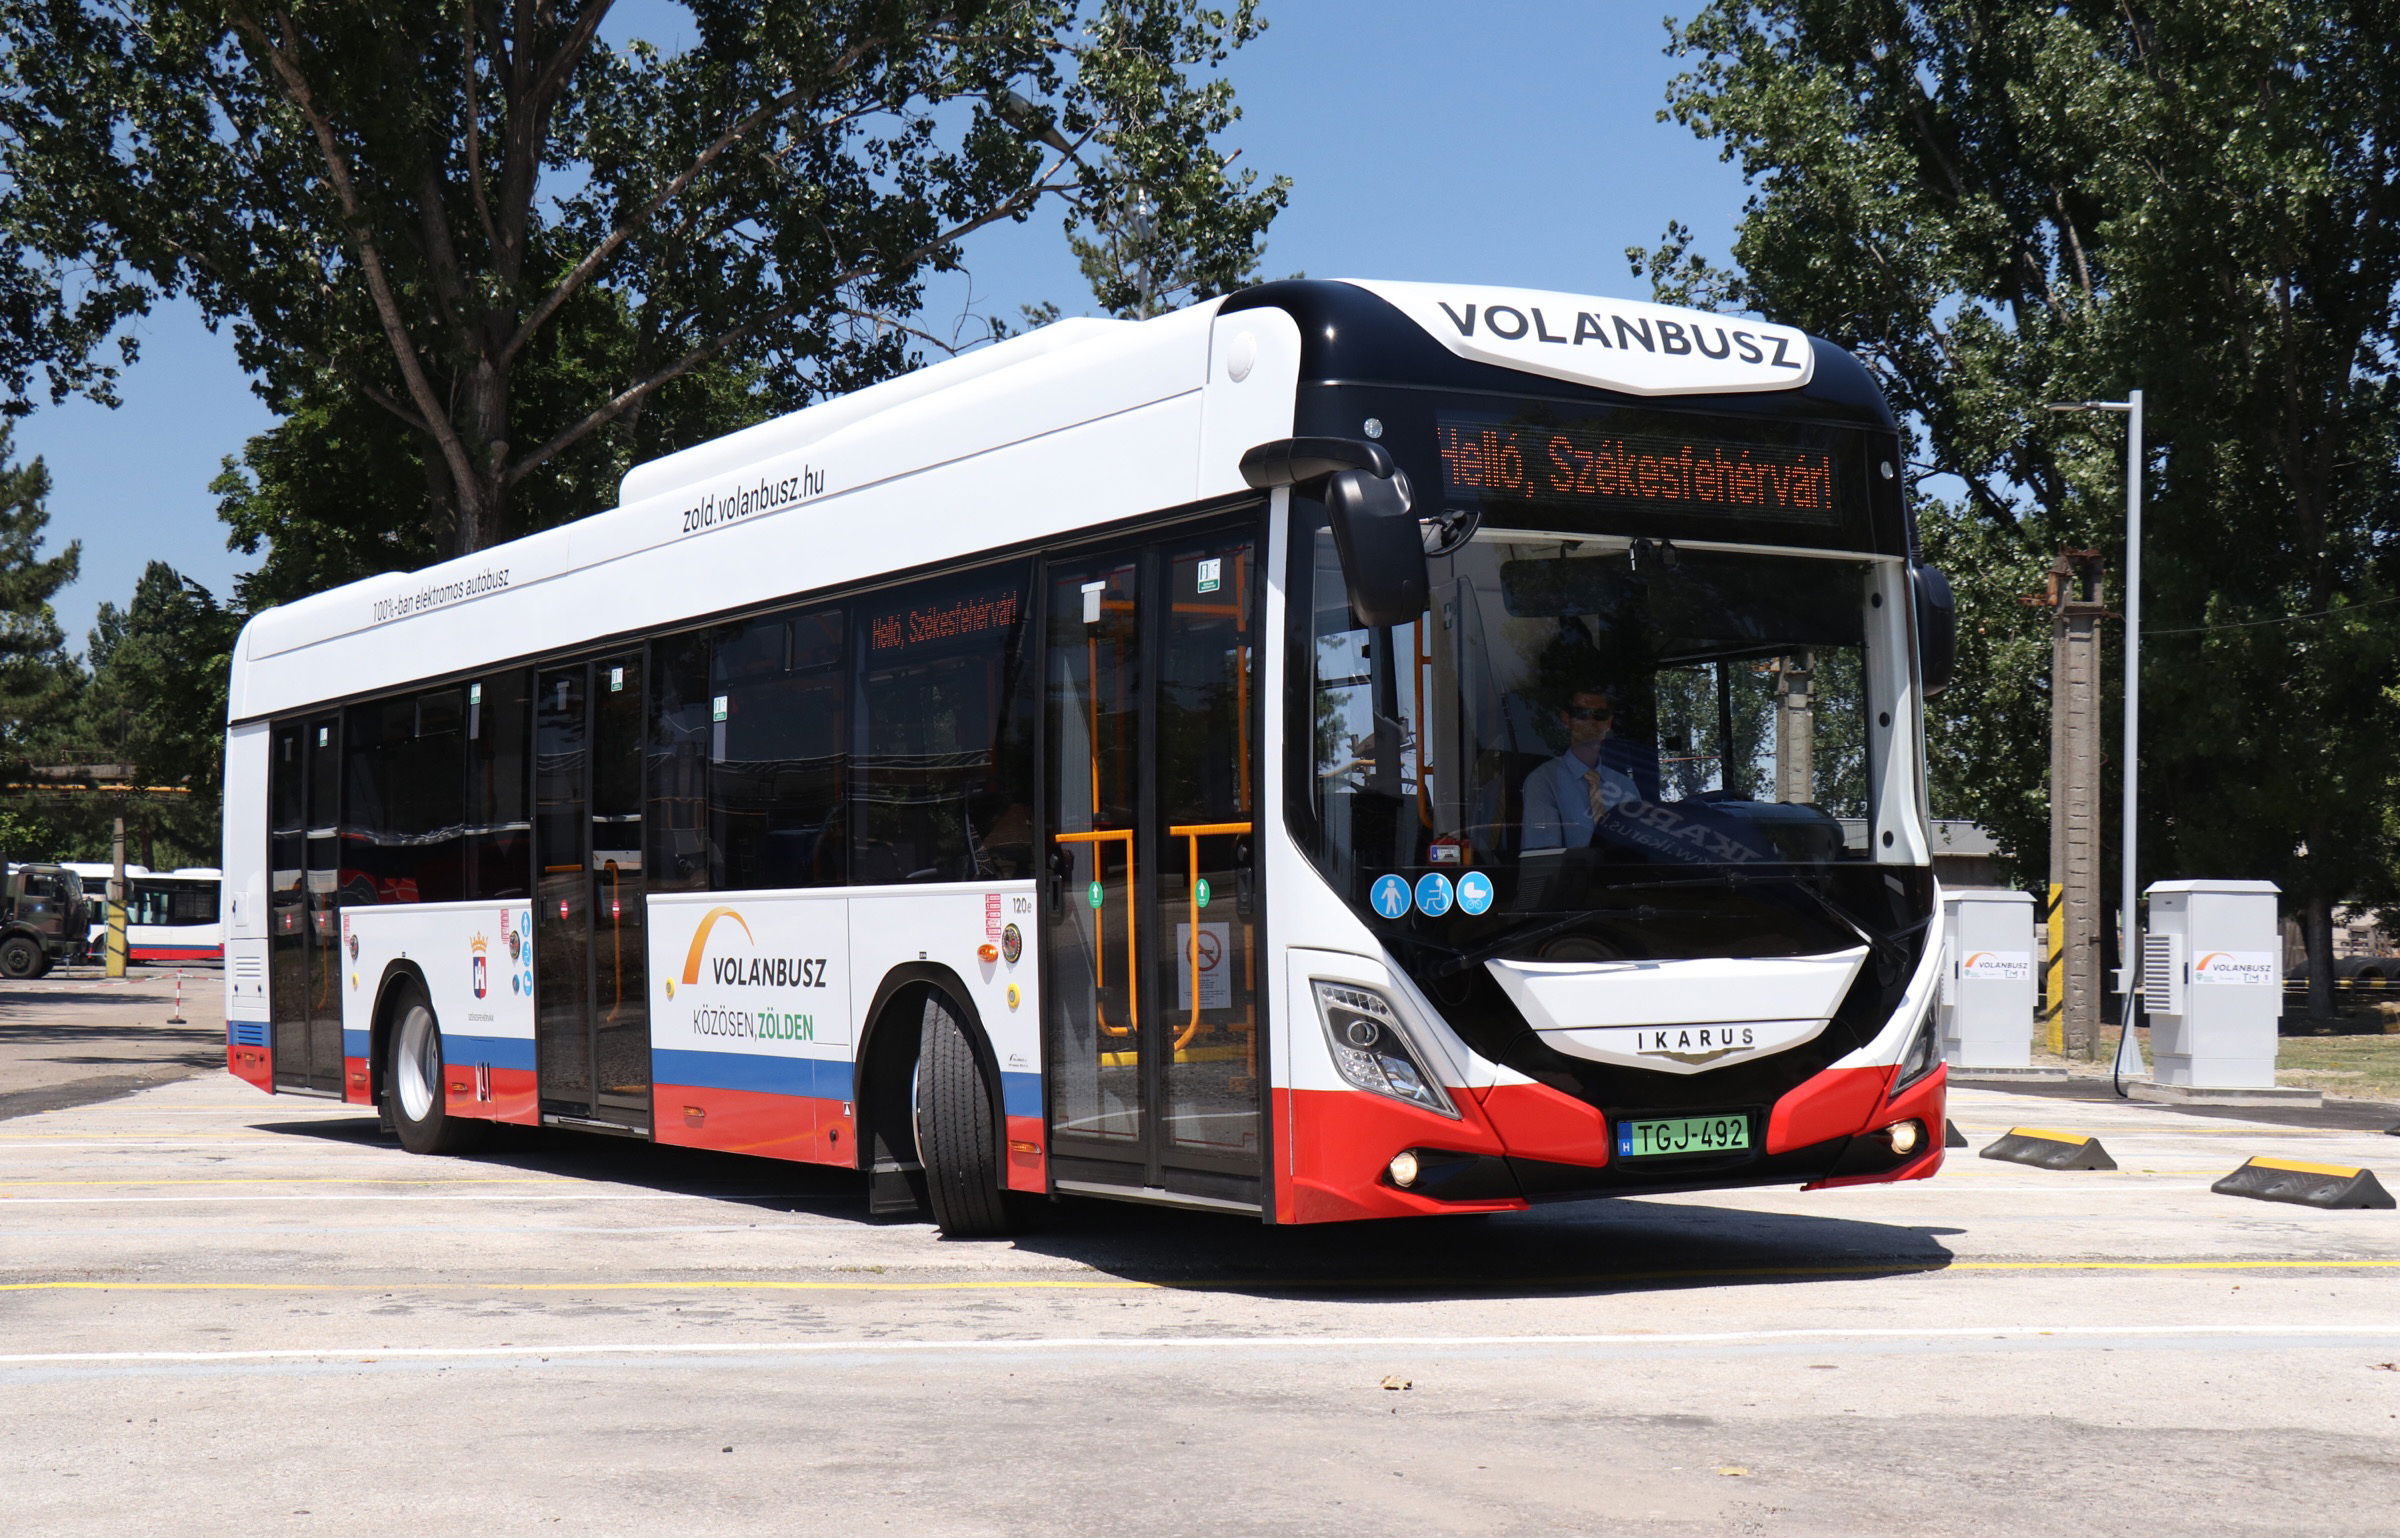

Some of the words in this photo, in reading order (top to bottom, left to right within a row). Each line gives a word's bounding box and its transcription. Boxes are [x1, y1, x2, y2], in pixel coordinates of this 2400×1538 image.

[1438, 301, 1802, 370] VOLÁNBUSZ
[1548, 435, 1832, 510] Székesfehérvár!
[683, 464, 825, 533] zold.volanbusz.hu
[373, 595, 414, 623] 100%-ban
[415, 581, 464, 611] elektromos
[465, 567, 510, 597] autóbusz
[1012, 896, 1032, 914] 120e
[713, 957, 827, 988] VOLÁNBUSZ
[1637, 1028, 1754, 1050] IKARUS
[1622, 1142, 1630, 1152] H
[1637, 1119, 1743, 1152] TGJ-492
